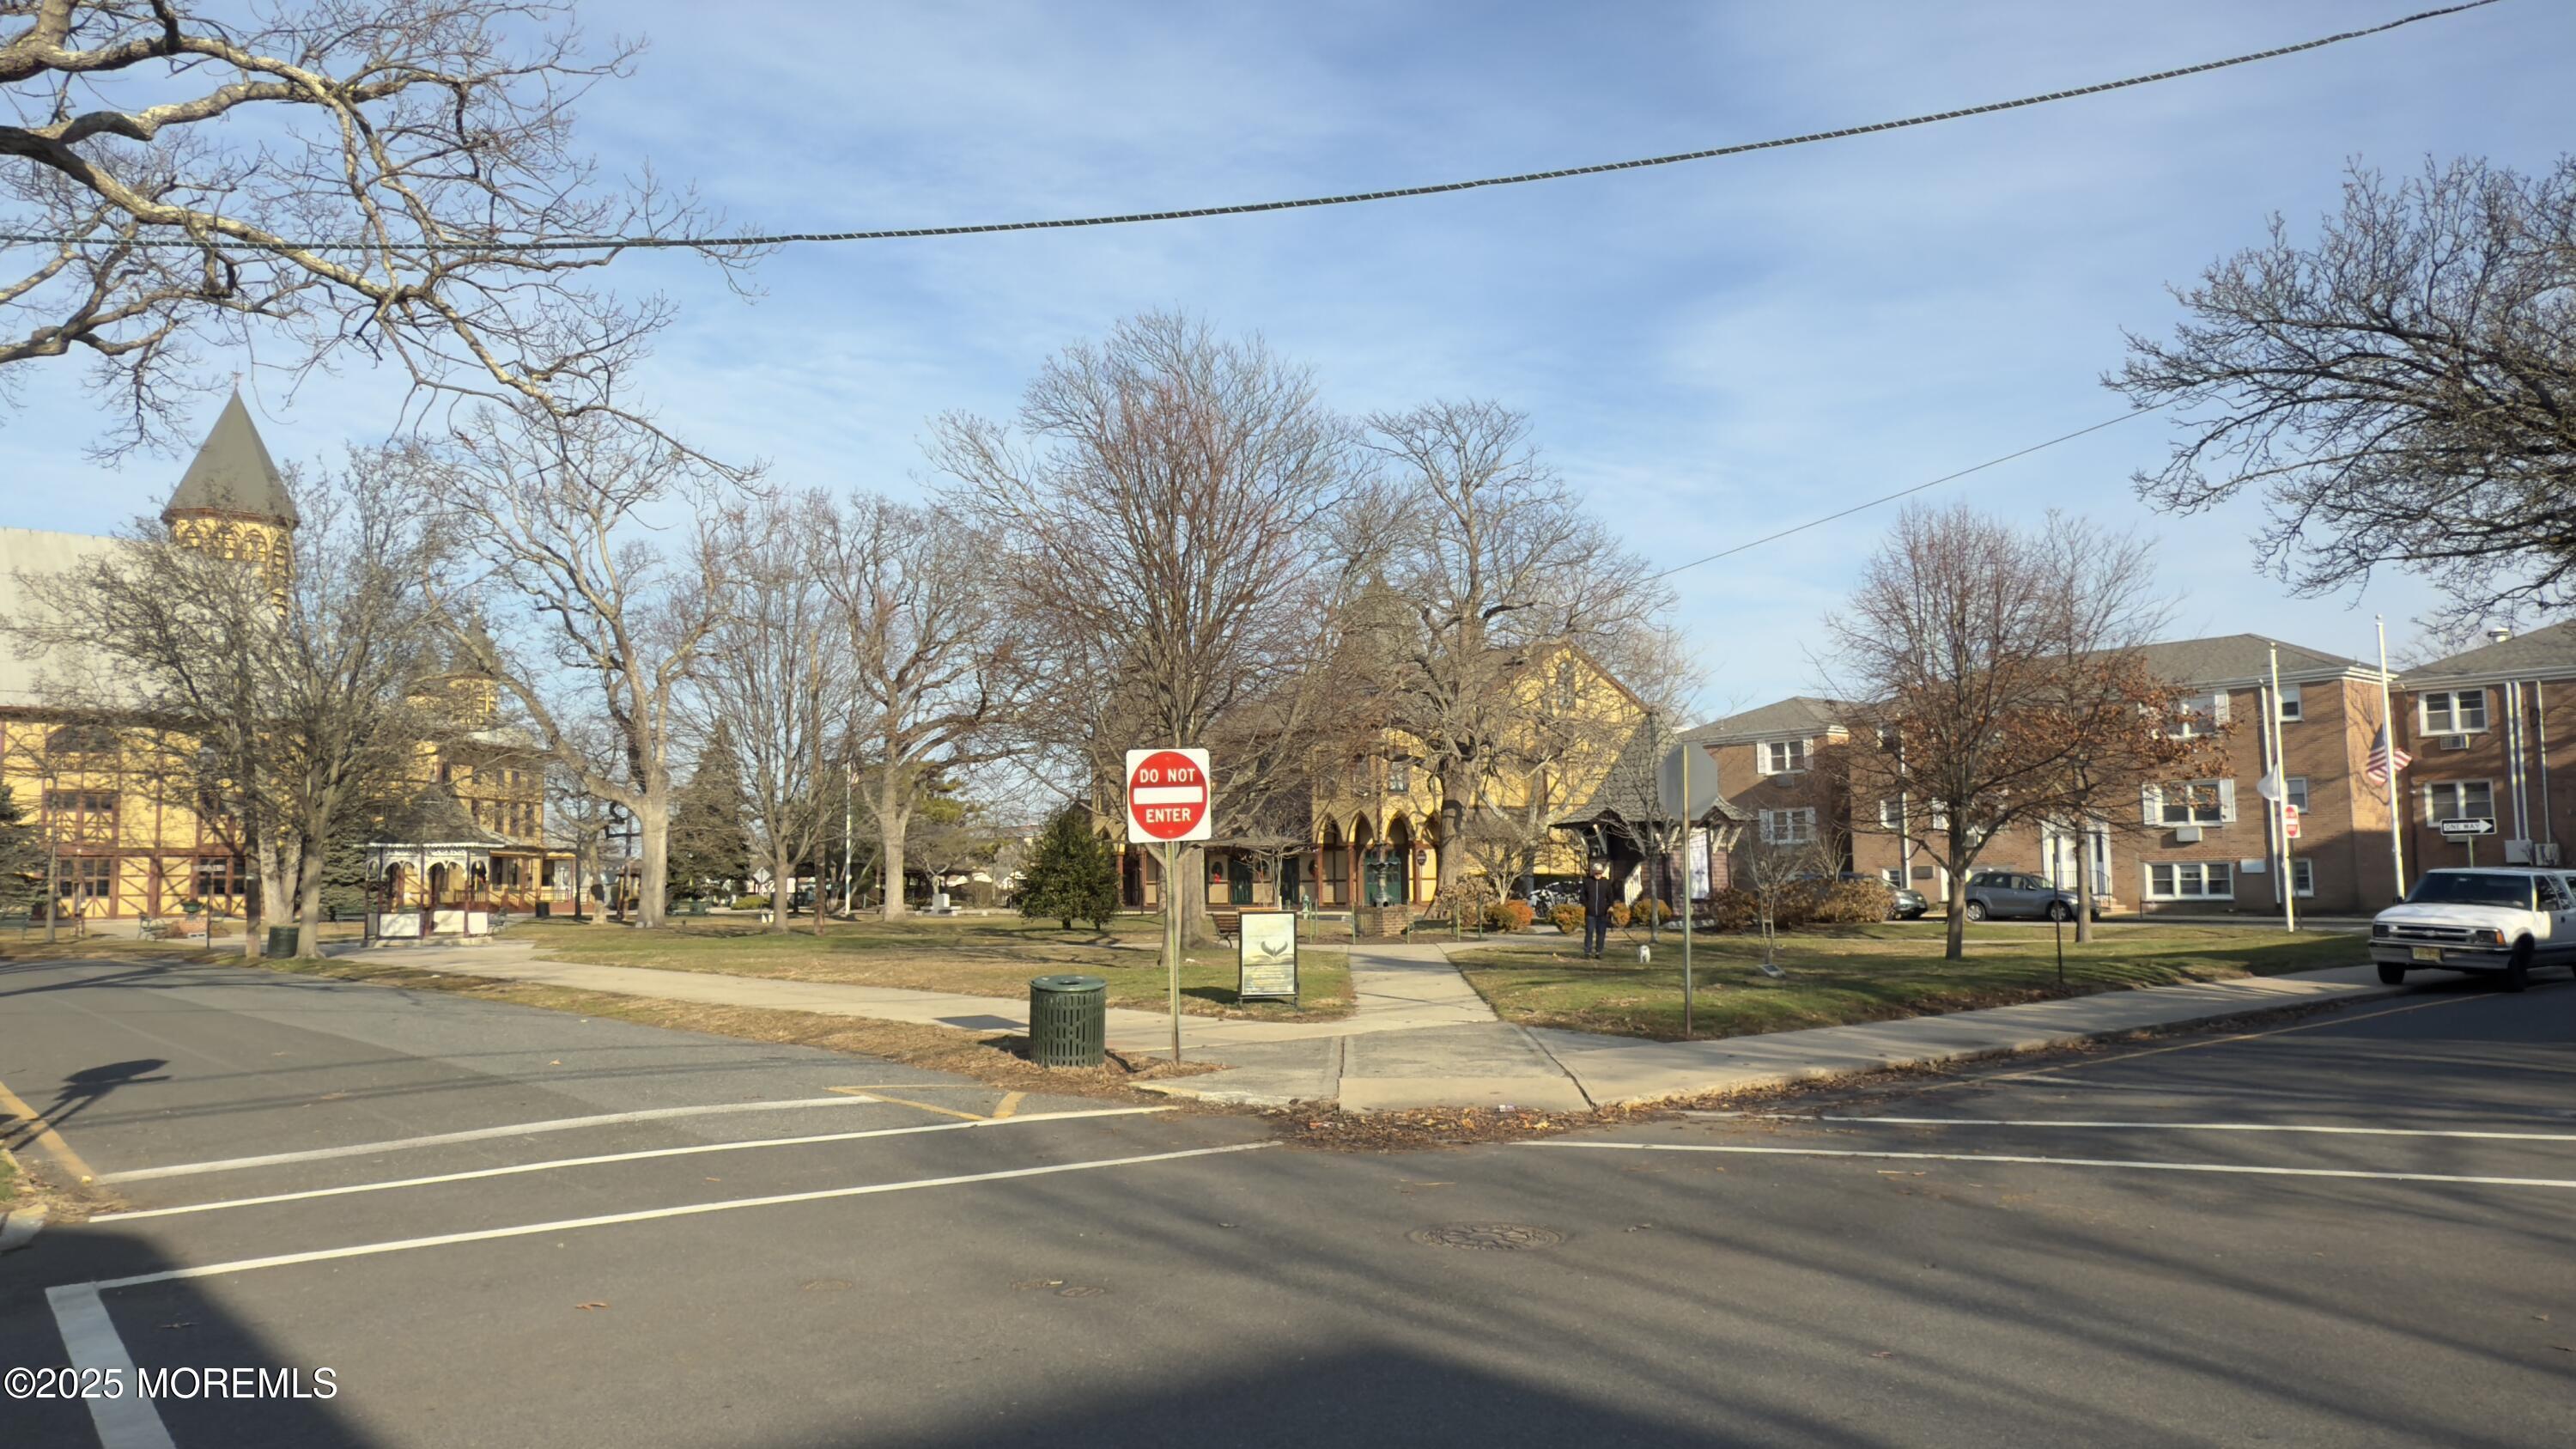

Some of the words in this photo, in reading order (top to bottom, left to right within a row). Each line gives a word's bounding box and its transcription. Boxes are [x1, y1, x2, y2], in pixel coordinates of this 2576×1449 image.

[1139, 768, 1159, 783] DO
[1167, 768, 1195, 782] NOT
[1145, 808, 1191, 823] ENTER
